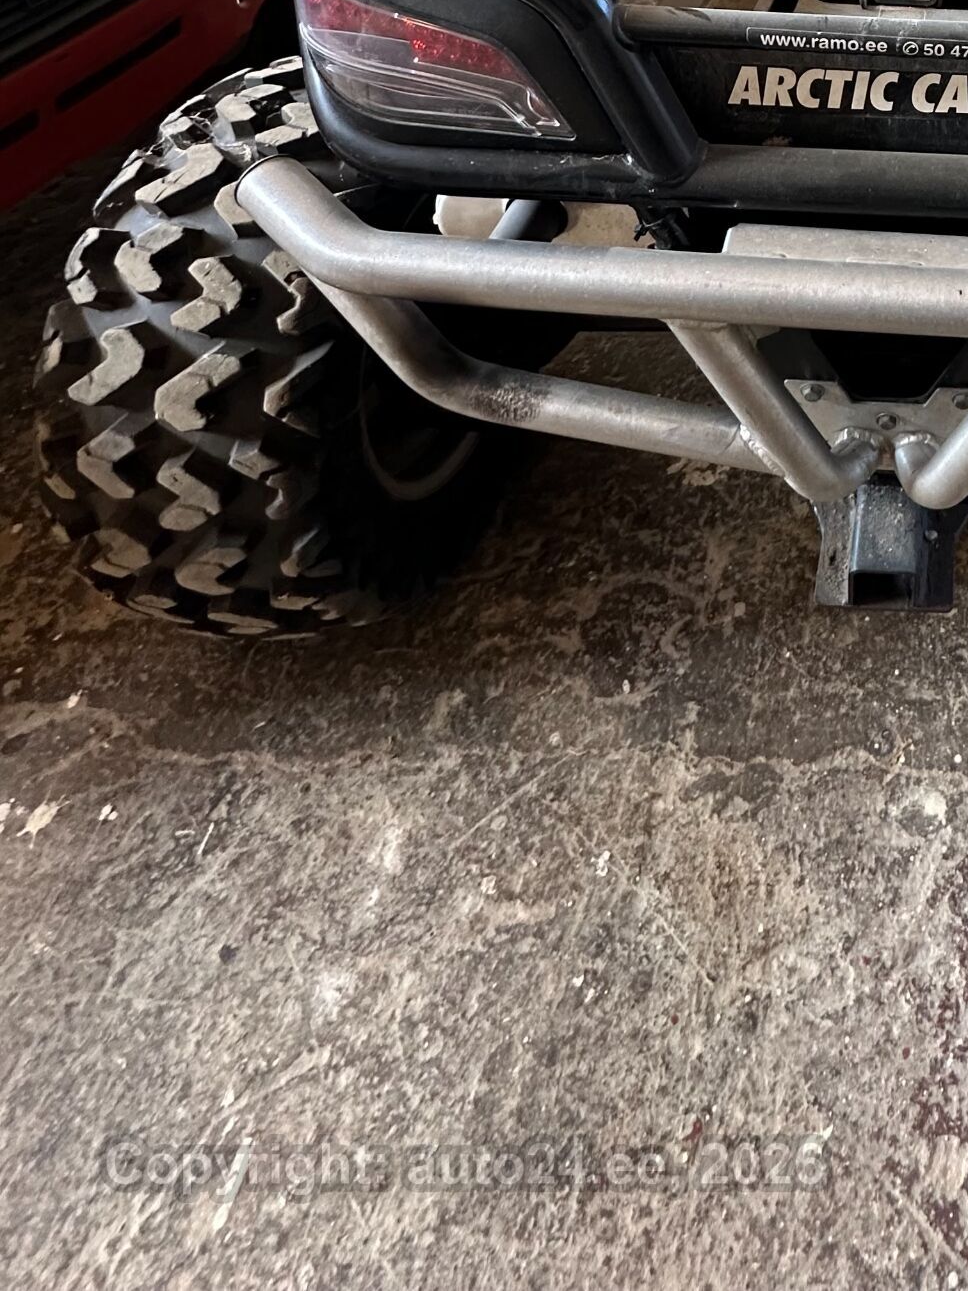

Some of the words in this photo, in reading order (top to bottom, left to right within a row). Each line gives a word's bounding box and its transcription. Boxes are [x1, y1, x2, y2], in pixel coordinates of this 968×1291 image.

[760, 33, 888, 53] www.ramo.ee
[923, 44, 945, 57] 50
[727, 66, 900, 112] ARCTIC
